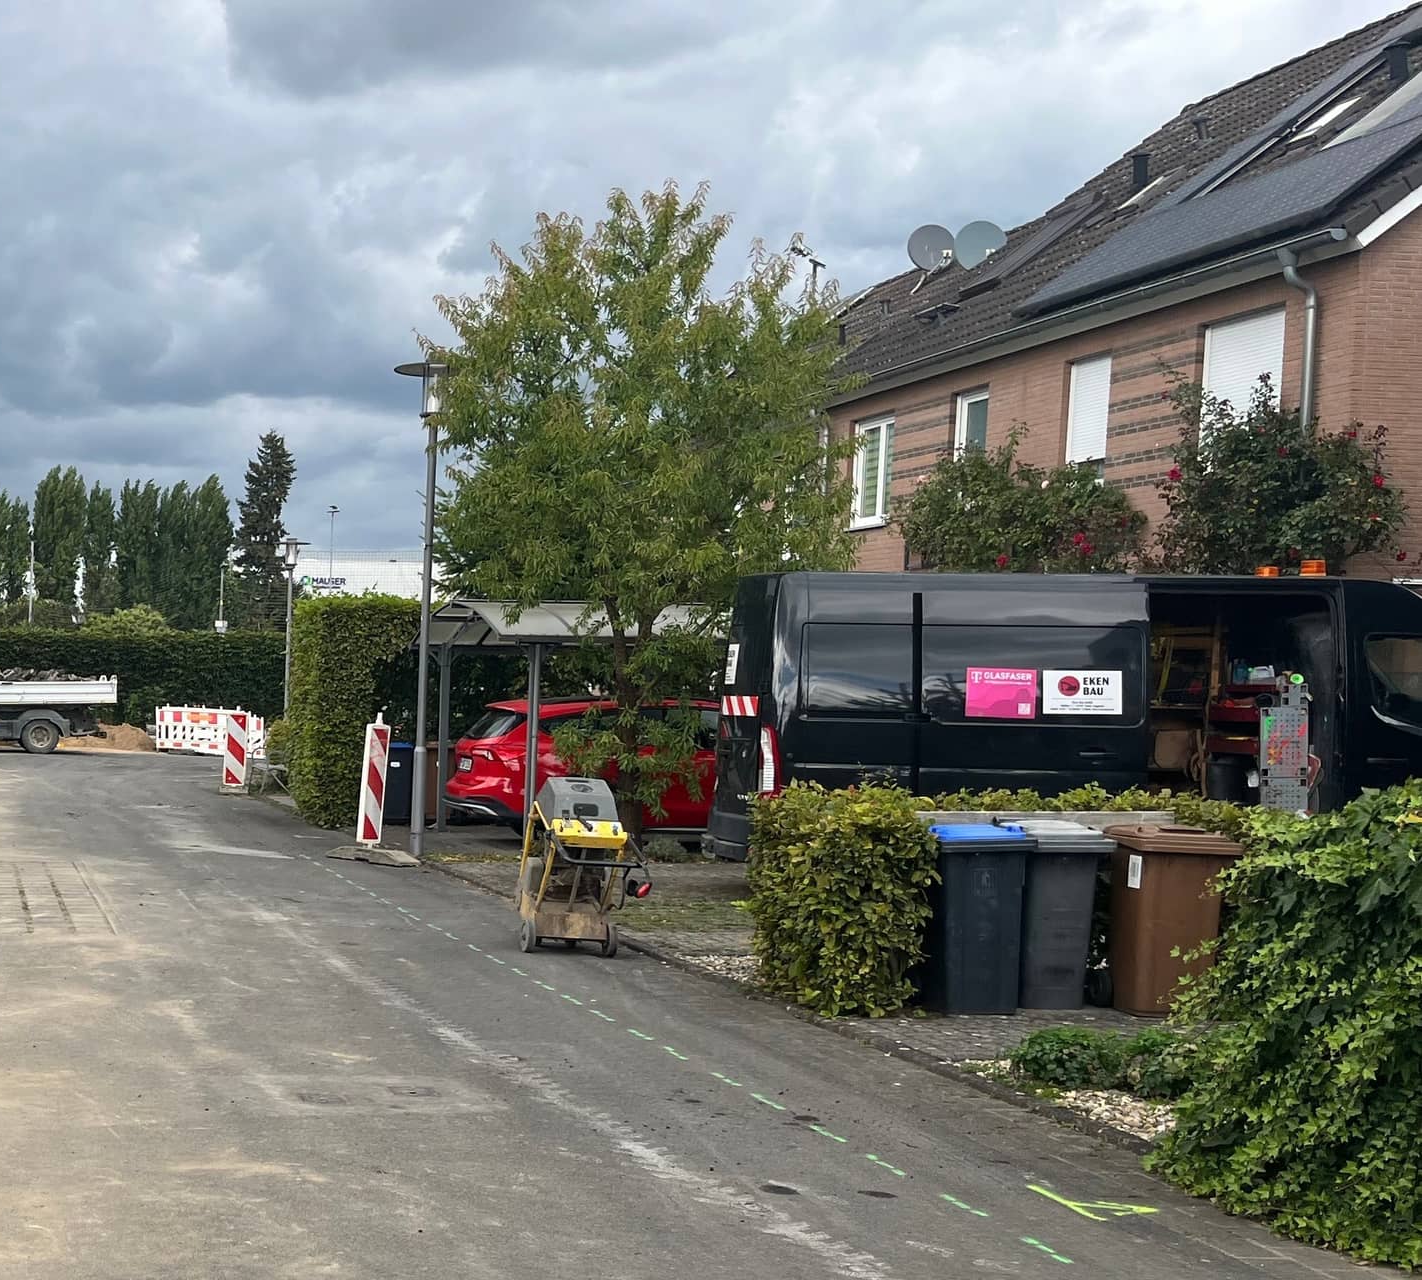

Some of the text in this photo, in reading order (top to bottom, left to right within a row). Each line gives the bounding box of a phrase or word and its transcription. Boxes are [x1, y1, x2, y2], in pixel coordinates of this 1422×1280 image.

[984, 671, 1033, 681] GLASFASER
[1083, 676, 1110, 686] EKEN
[1083, 687, 1104, 696] BAU
